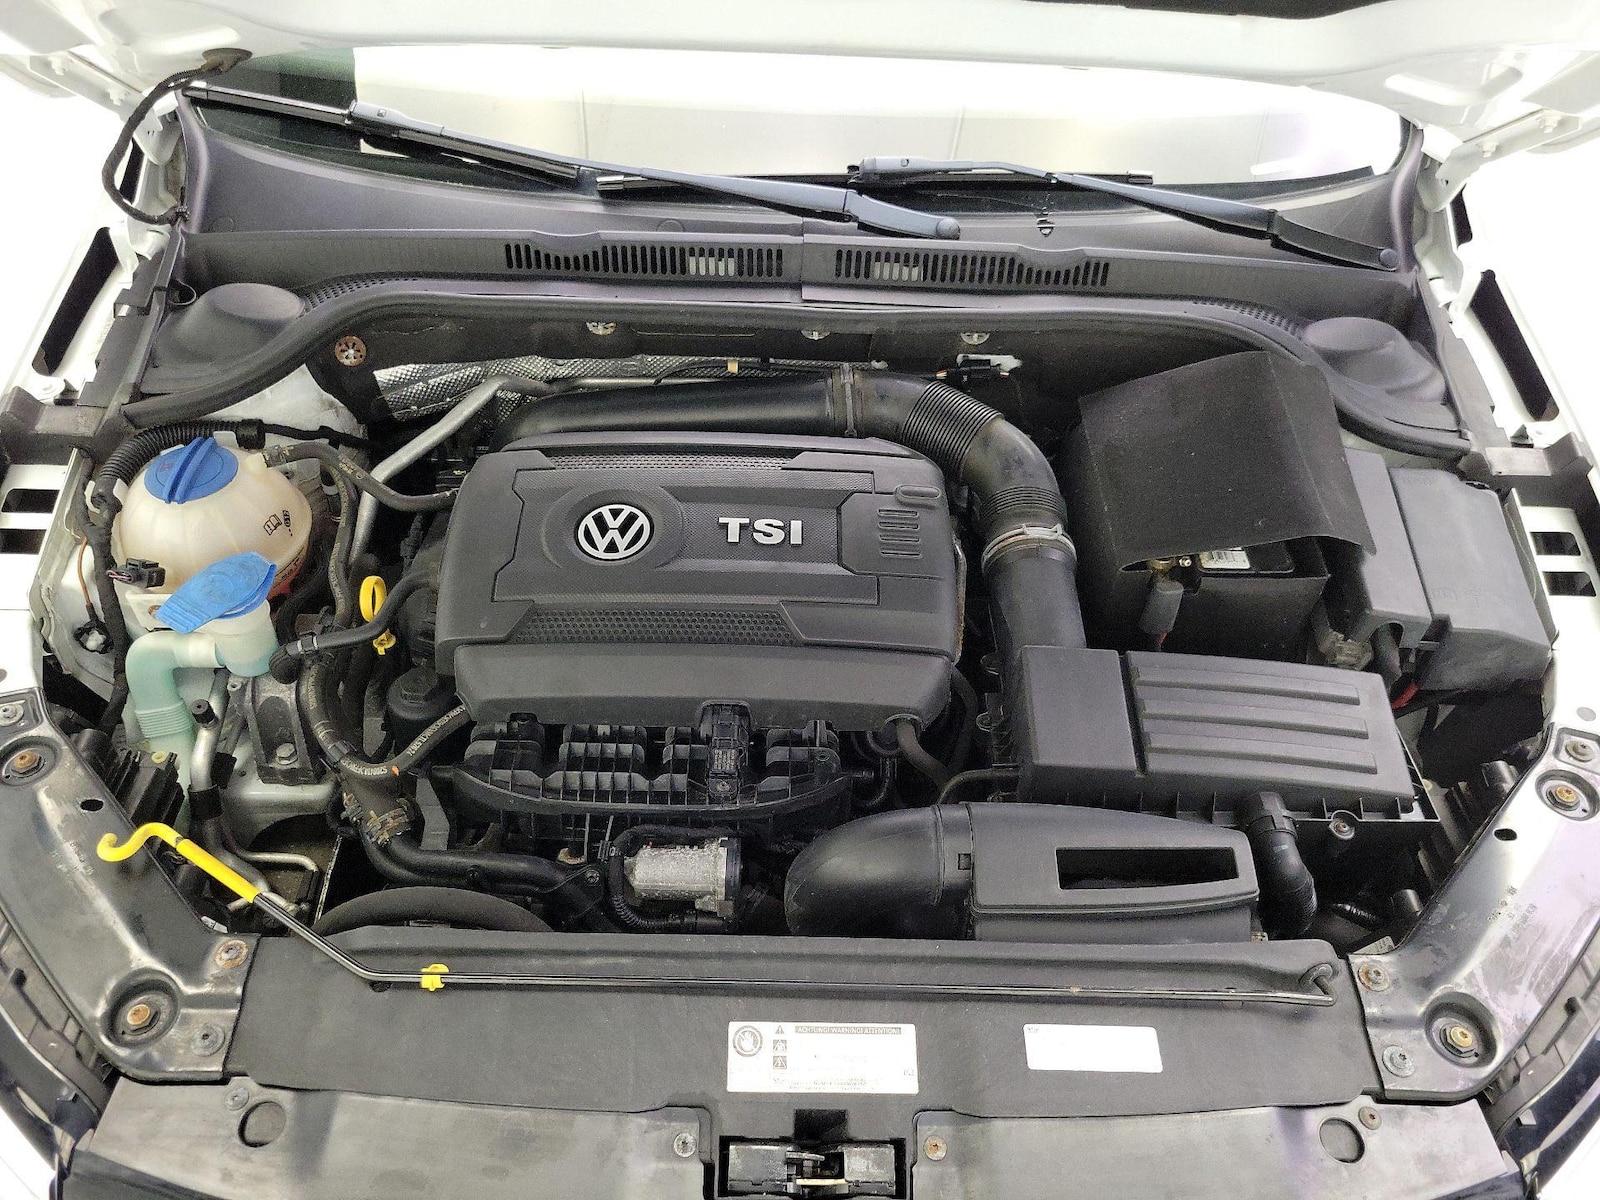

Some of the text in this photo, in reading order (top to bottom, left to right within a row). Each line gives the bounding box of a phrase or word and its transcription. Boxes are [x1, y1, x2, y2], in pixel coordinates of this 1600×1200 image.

[718, 517, 803, 546] TSI
[797, 1026, 900, 1036] ACHTUNG! WARNING! ATTENTION!
